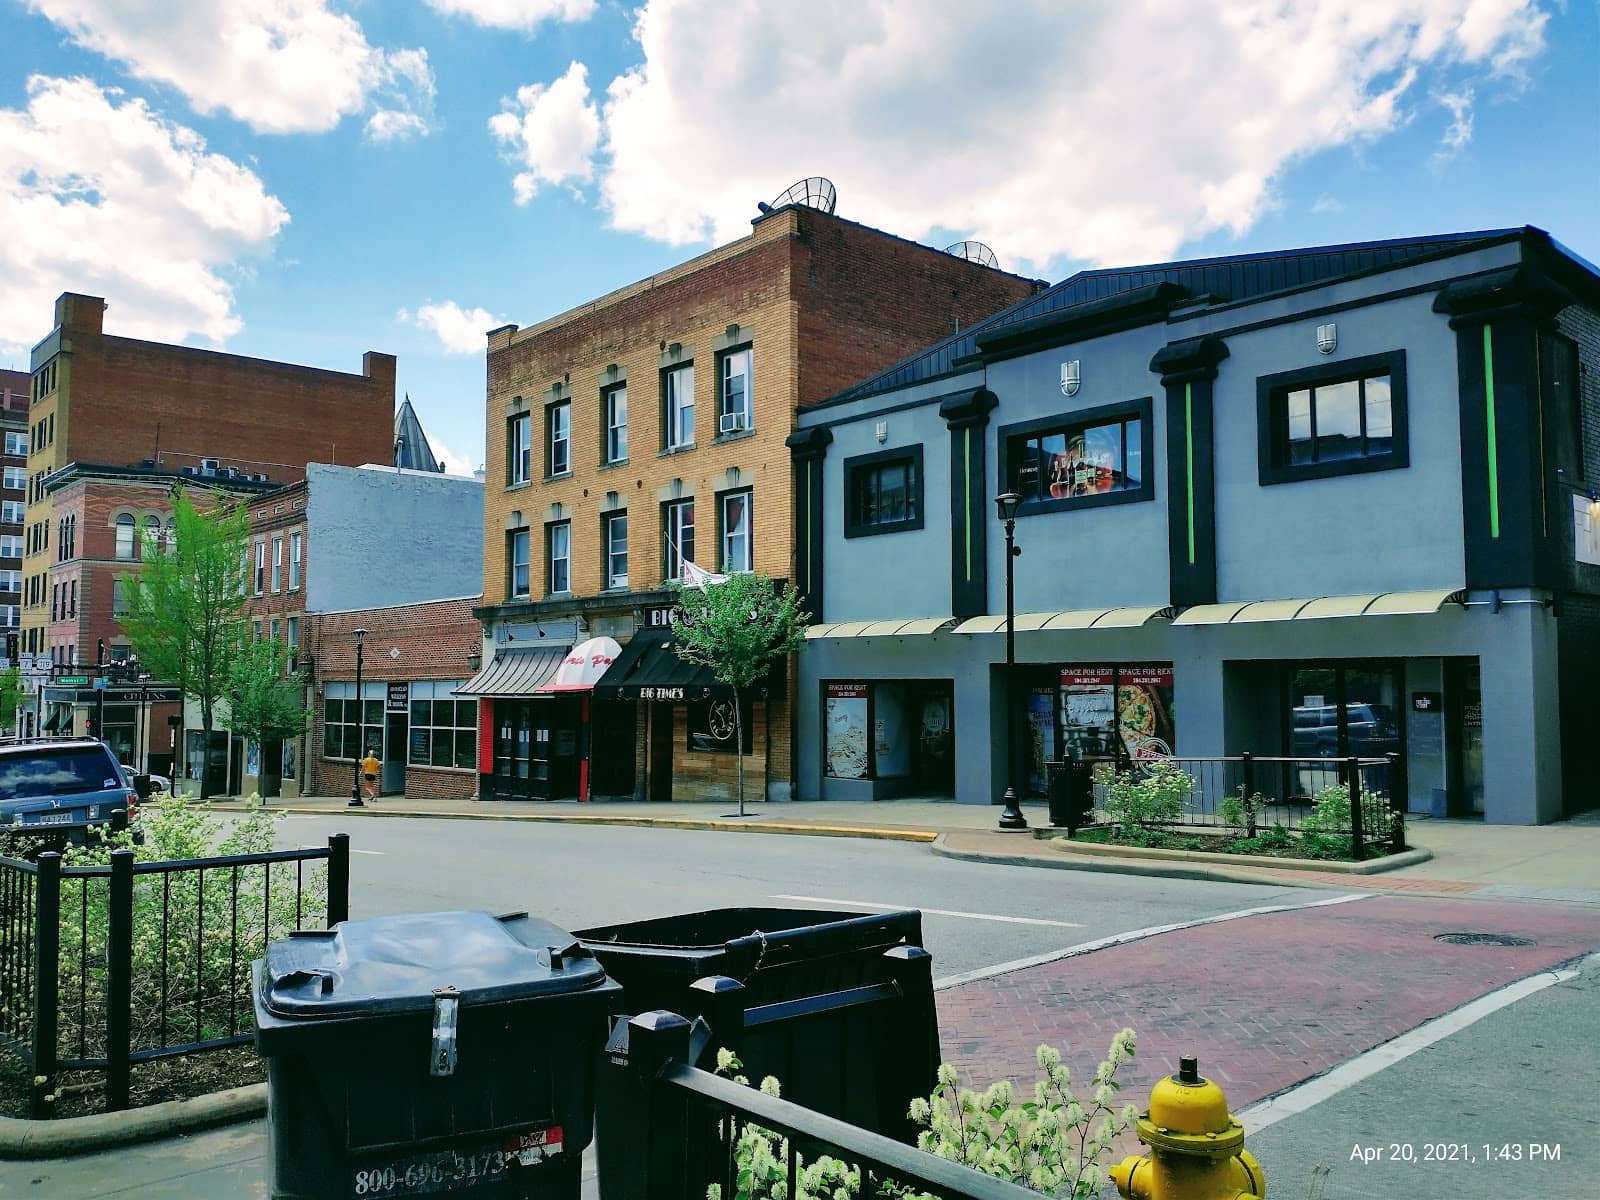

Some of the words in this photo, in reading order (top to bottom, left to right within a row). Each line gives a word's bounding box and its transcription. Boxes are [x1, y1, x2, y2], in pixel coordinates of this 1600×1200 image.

[651, 608, 679, 626] BIG
[1060, 668, 1081, 676] SPACE
[1083, 668, 1096, 676] FOR
[1097, 668, 1113, 676] RENT
[1118, 668, 1141, 676] SPACE
[640, 687, 654, 698] BIG
